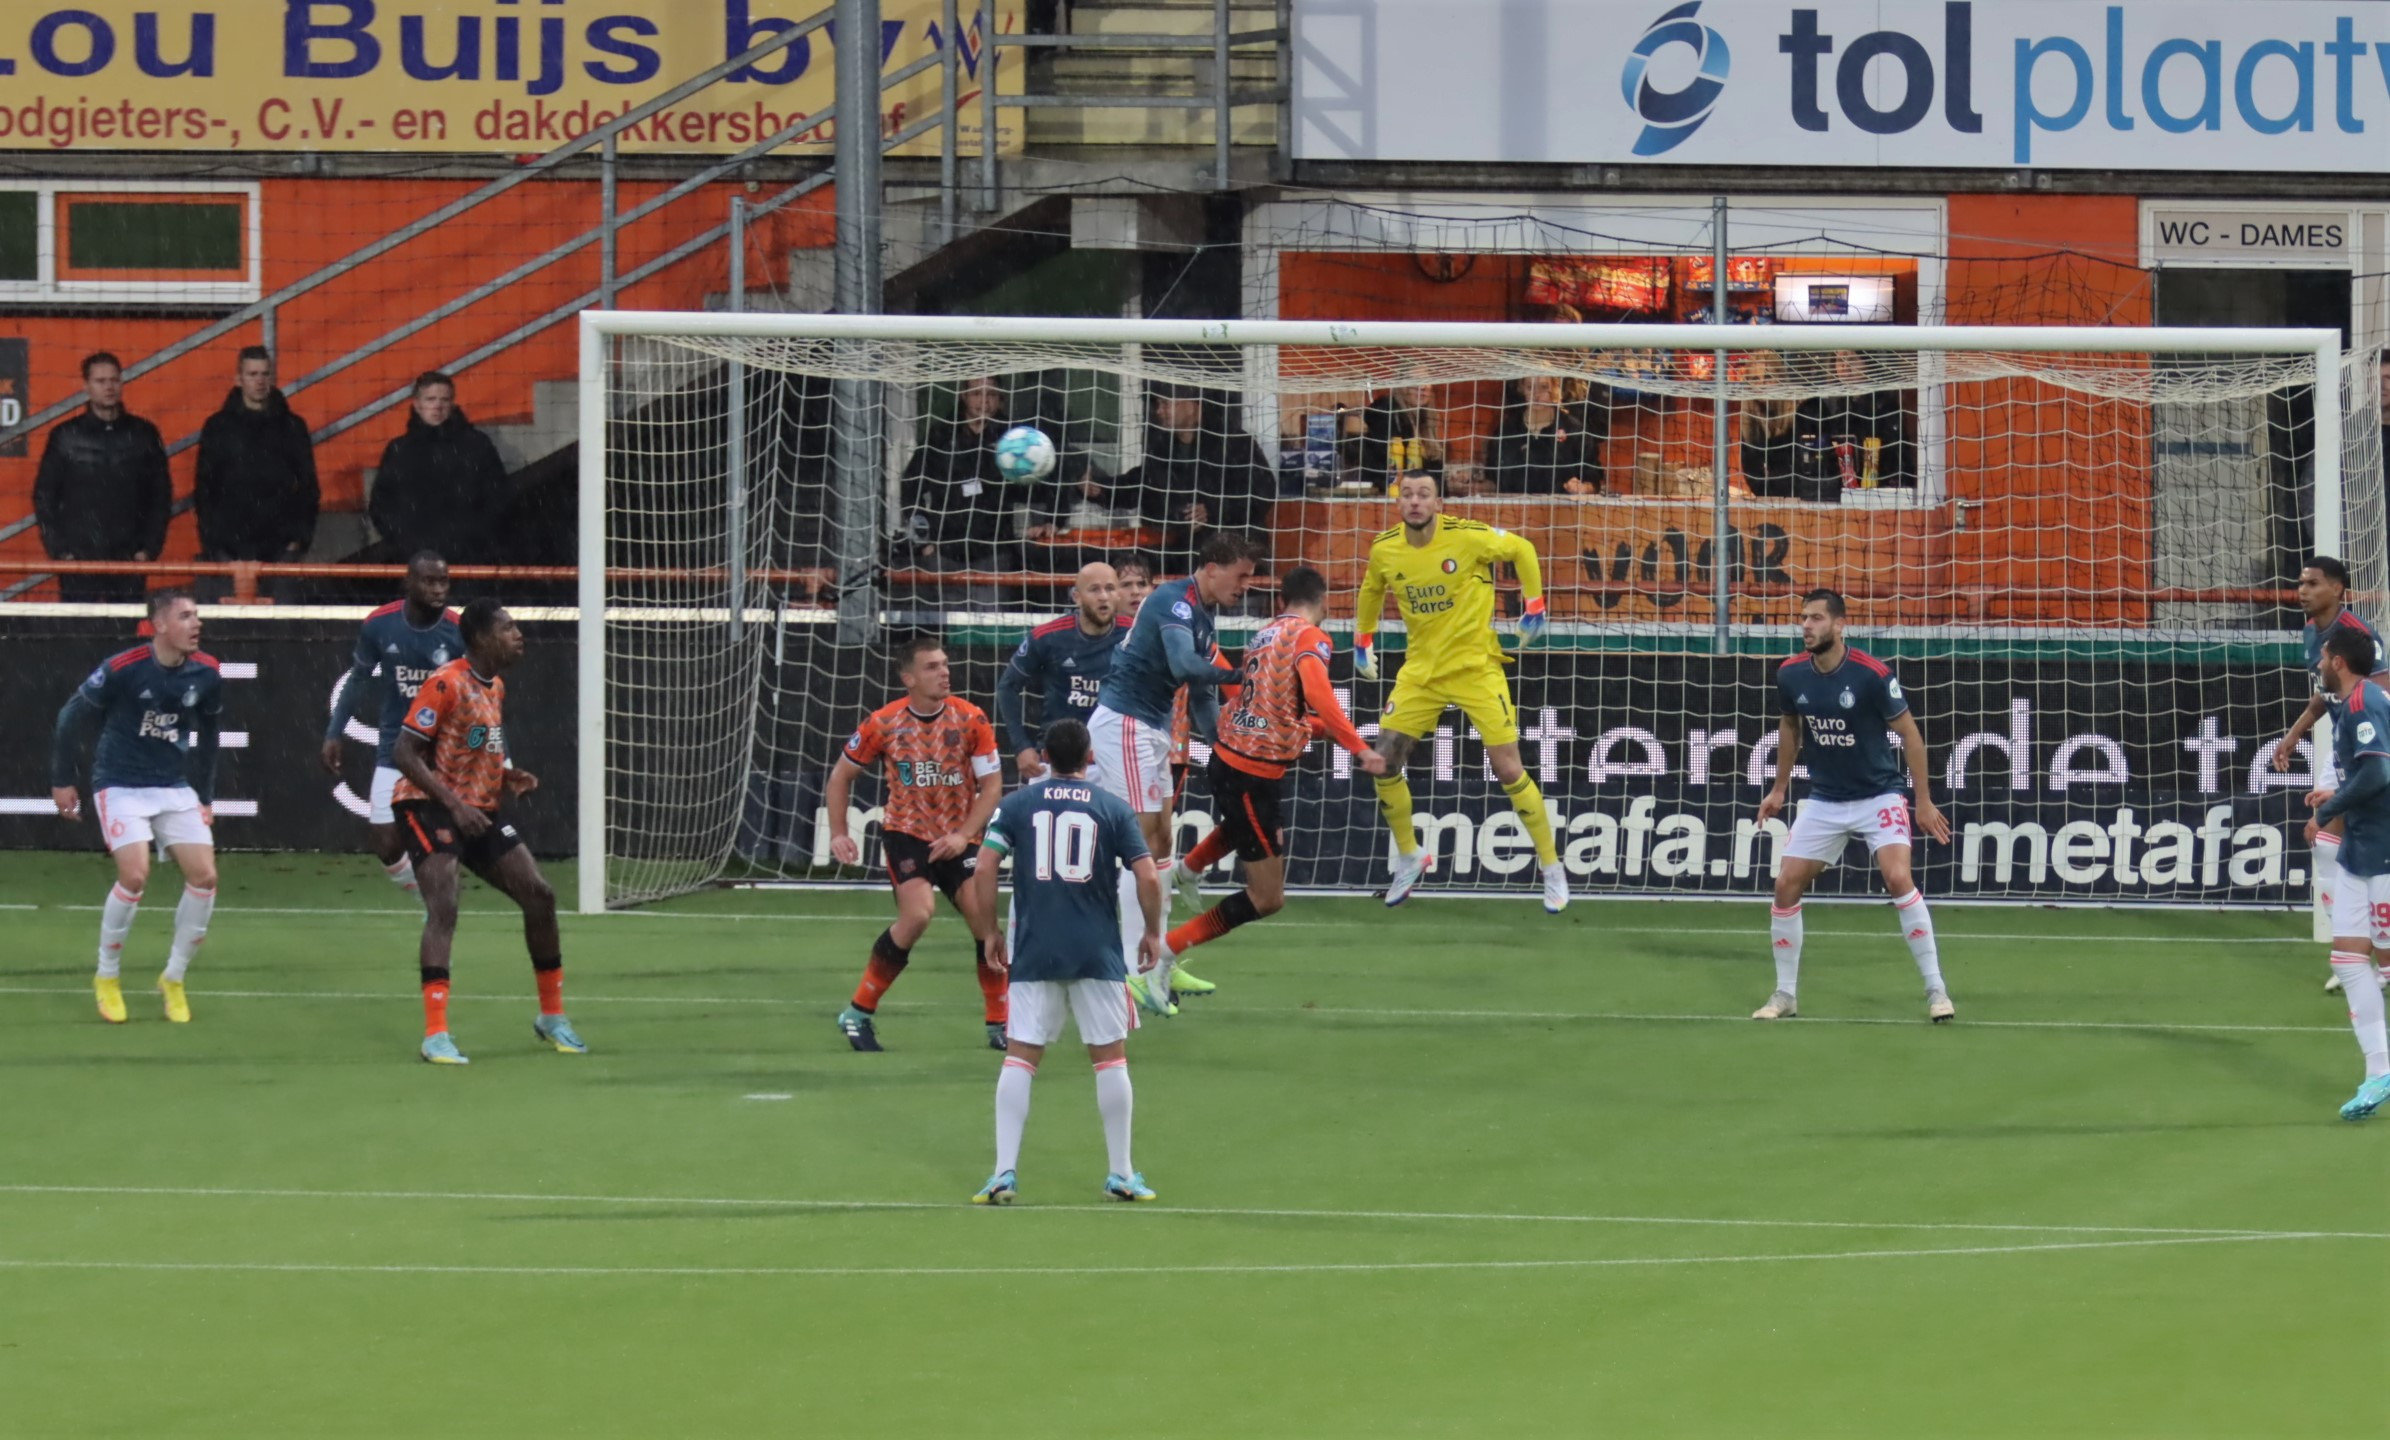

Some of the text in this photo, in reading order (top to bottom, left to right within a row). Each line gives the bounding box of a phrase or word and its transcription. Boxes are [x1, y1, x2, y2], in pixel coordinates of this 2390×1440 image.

[283, 0, 661, 95] Buijs
[1779, 1, 1982, 134] tol
[392, 107, 446, 140] en
[2160, 222, 2210, 246] WC
[2240, 223, 2342, 248] DAMES
[1406, 585, 1446, 600] Euro
[1410, 598, 1454, 615] Parcs
[1070, 675, 1101, 693] Eur
[1806, 715, 1846, 732] Euro
[1813, 730, 1856, 747] Parcs
[914, 761, 941, 775] BET
[915, 773, 964, 787] CITY.NL
[1877, 806, 1907, 829] 33
[1032, 810, 1098, 883] 10
